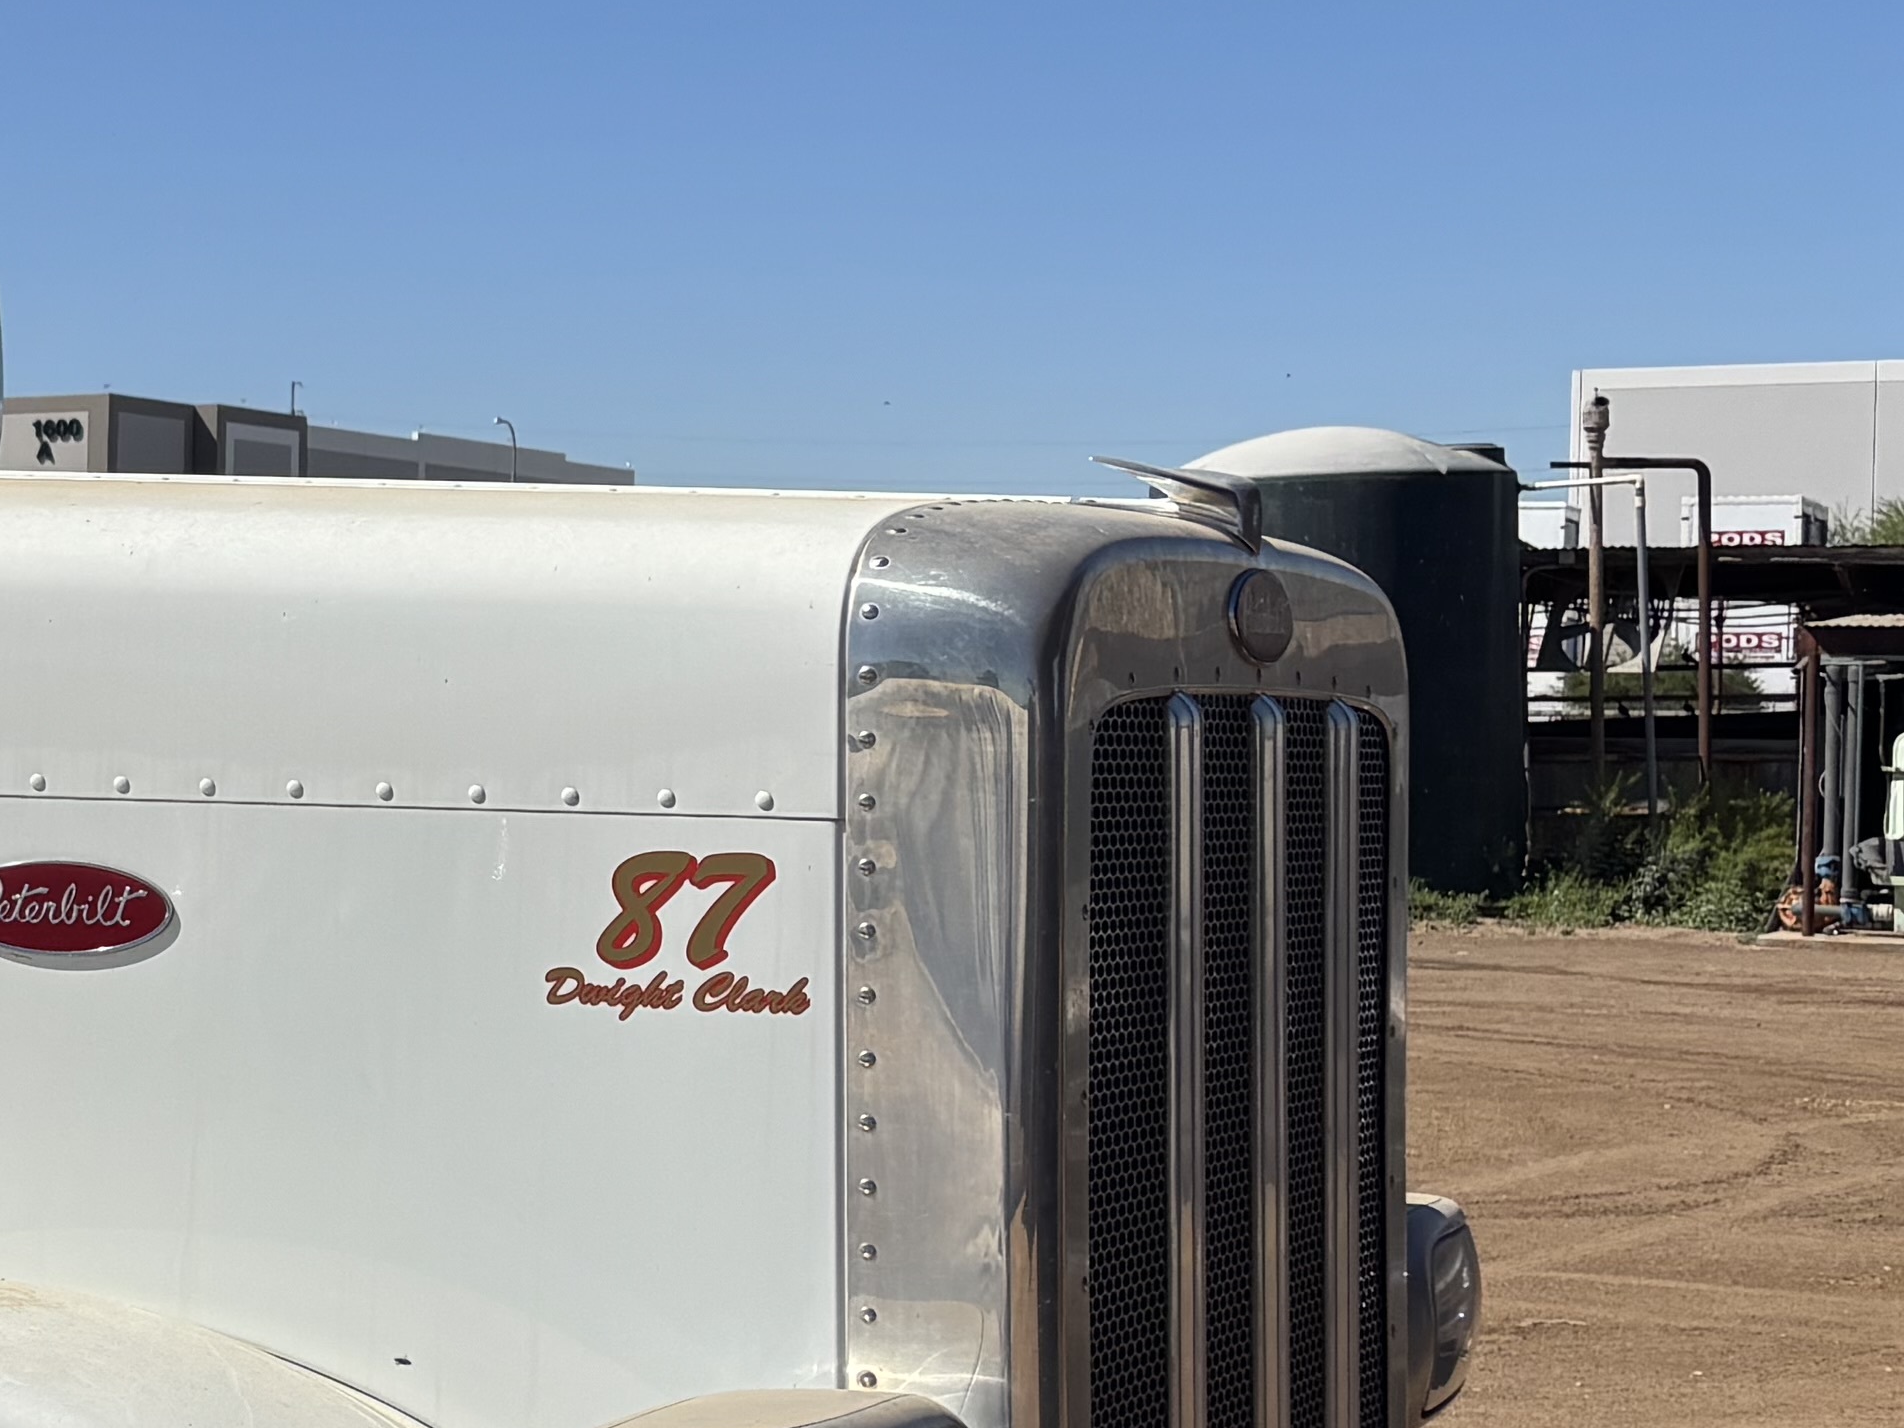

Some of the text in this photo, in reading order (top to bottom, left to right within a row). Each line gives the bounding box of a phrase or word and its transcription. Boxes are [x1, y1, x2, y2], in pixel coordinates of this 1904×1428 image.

[32, 418, 84, 443] 1600
[596, 851, 776, 971] 87
[545, 967, 810, 1021] Dwight Clark
